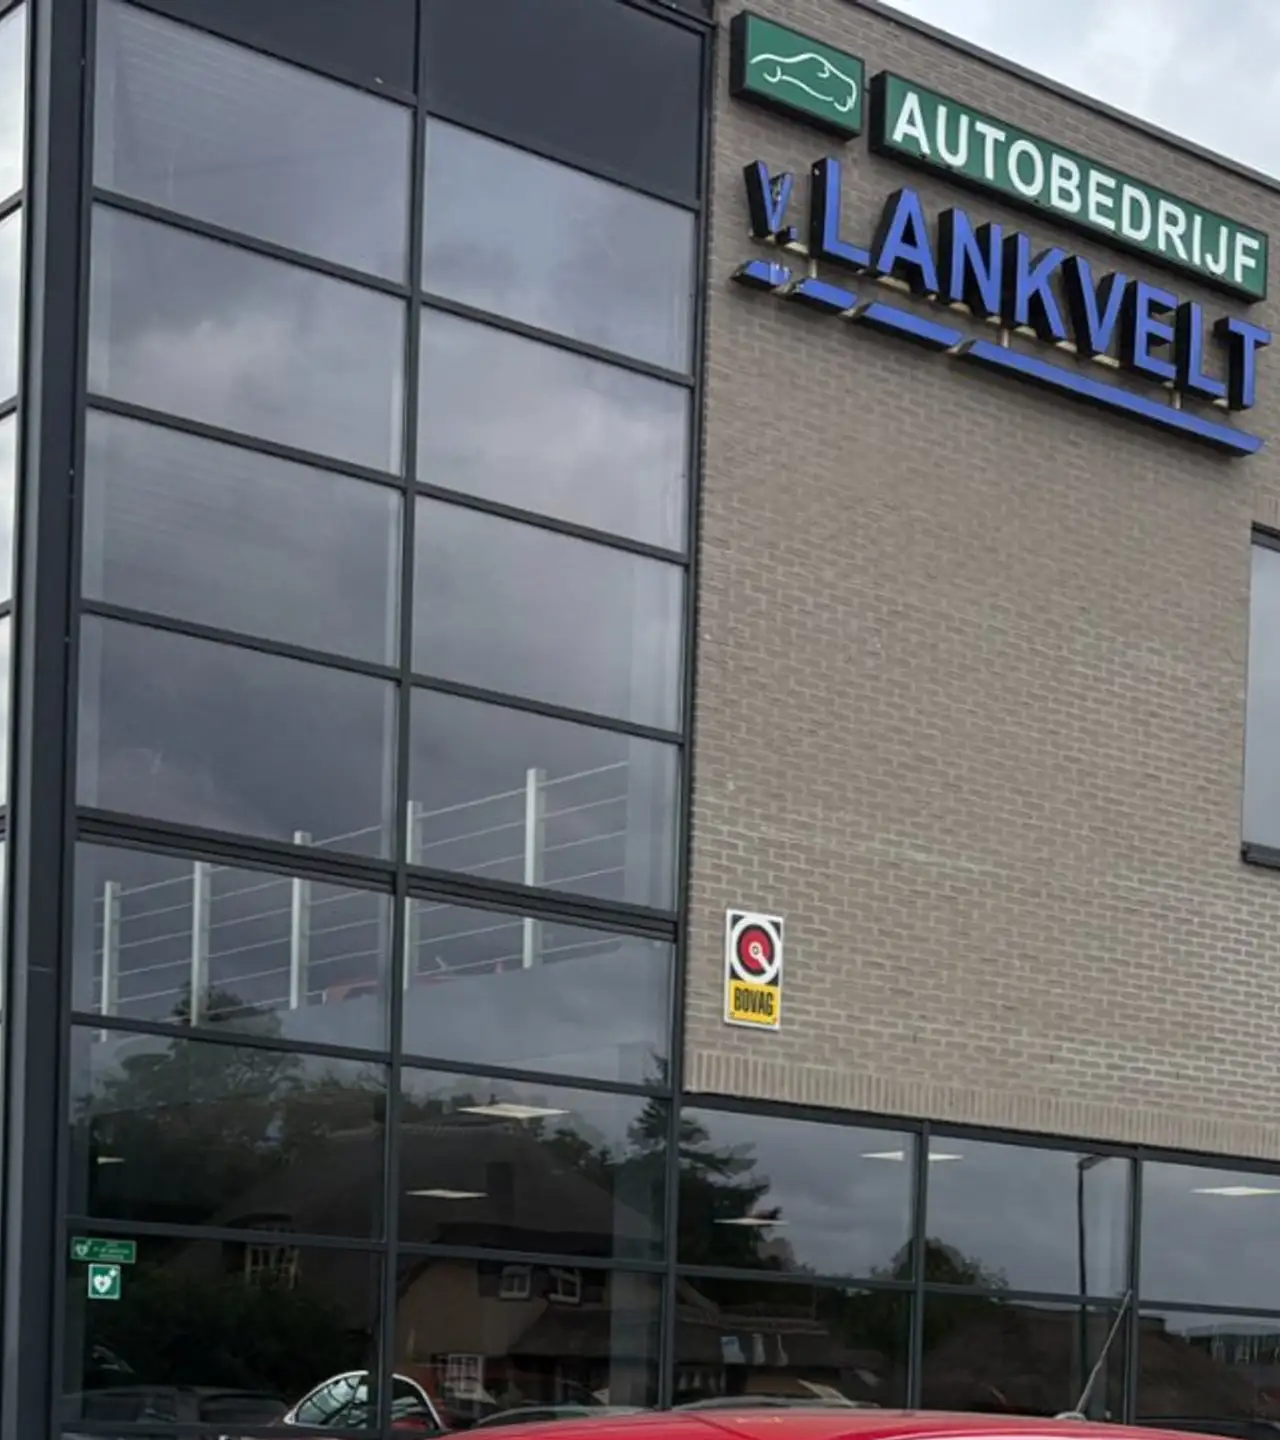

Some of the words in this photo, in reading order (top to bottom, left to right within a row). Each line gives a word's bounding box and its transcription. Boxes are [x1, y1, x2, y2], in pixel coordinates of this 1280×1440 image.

[812, 156, 1272, 410] LANKVELT
[890, 91, 1261, 284] AUTOBEDRIJF
[734, 986, 774, 1017] BOVAG
